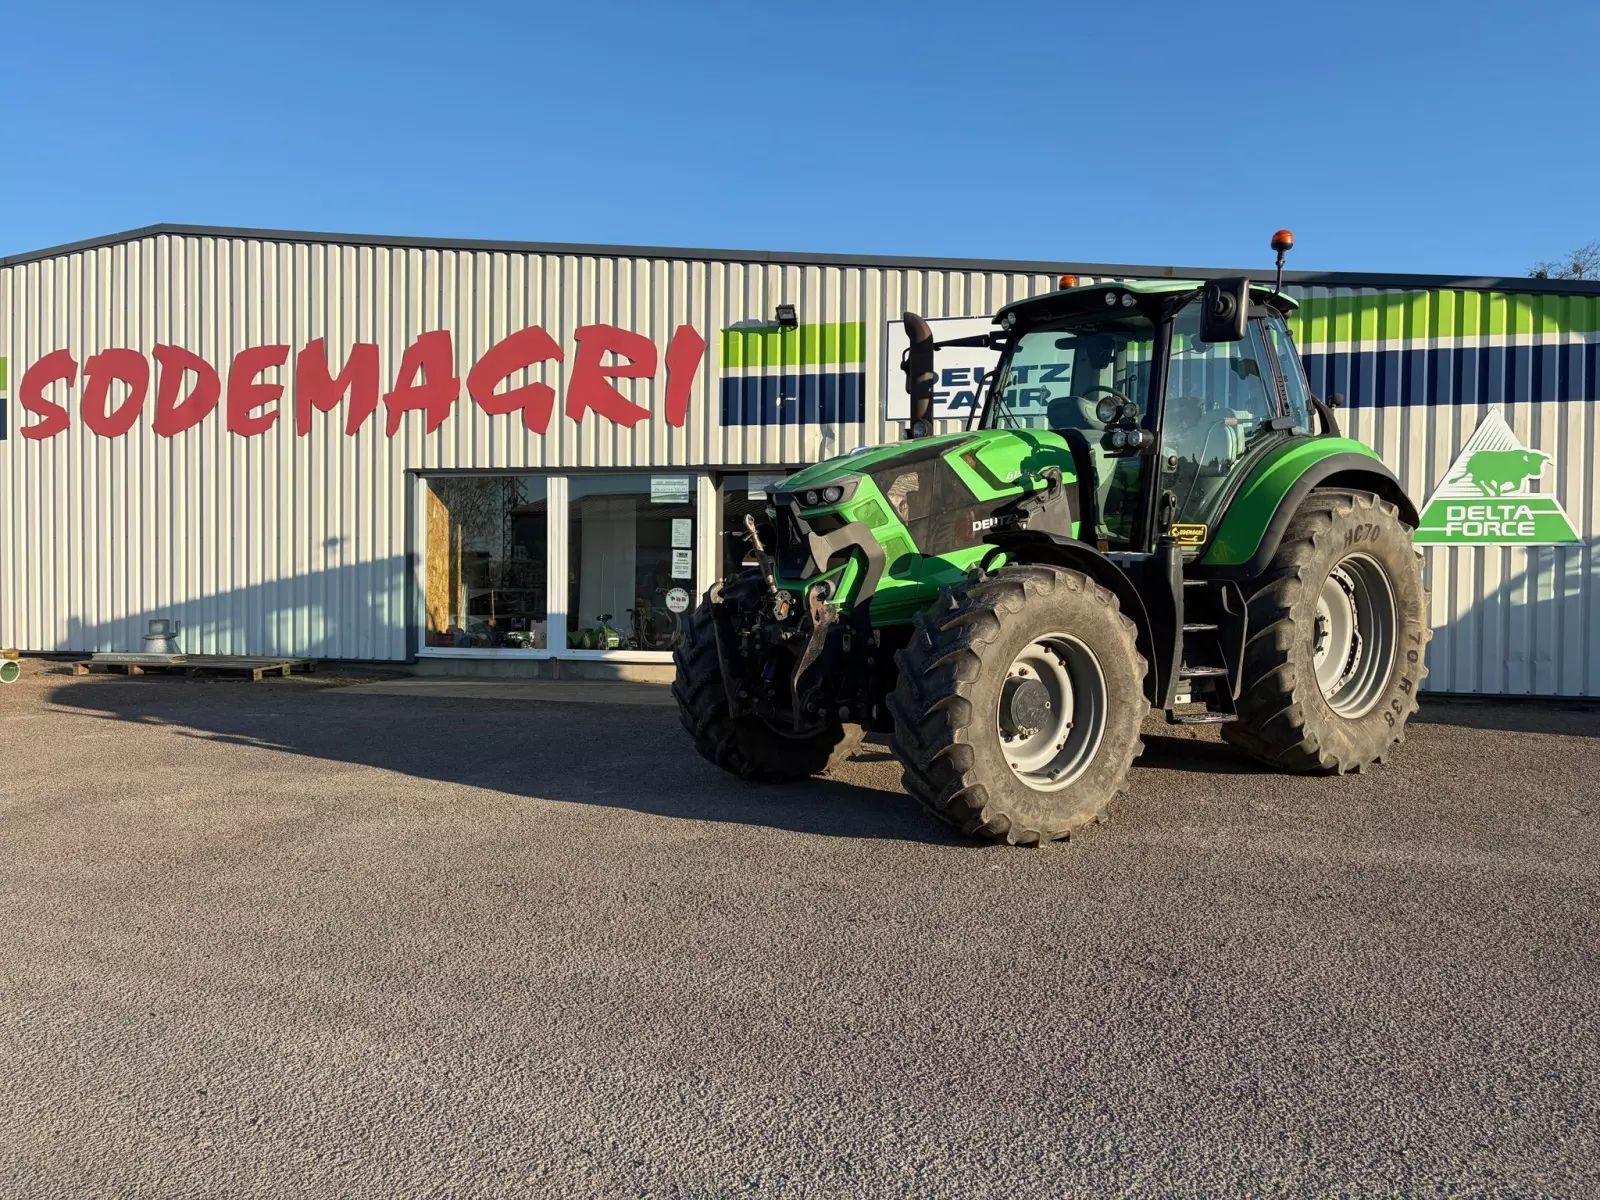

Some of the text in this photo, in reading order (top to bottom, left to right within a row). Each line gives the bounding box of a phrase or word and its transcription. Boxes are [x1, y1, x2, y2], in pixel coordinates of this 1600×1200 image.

[20, 323, 707, 440] SODEMAGRI
[932, 363, 1071, 387] EUTZ
[1446, 505, 1534, 521] DELTA
[1343, 522, 1381, 550] HC70
[1445, 521, 1536, 537] FORCE
[1398, 676, 1413, 697] R
